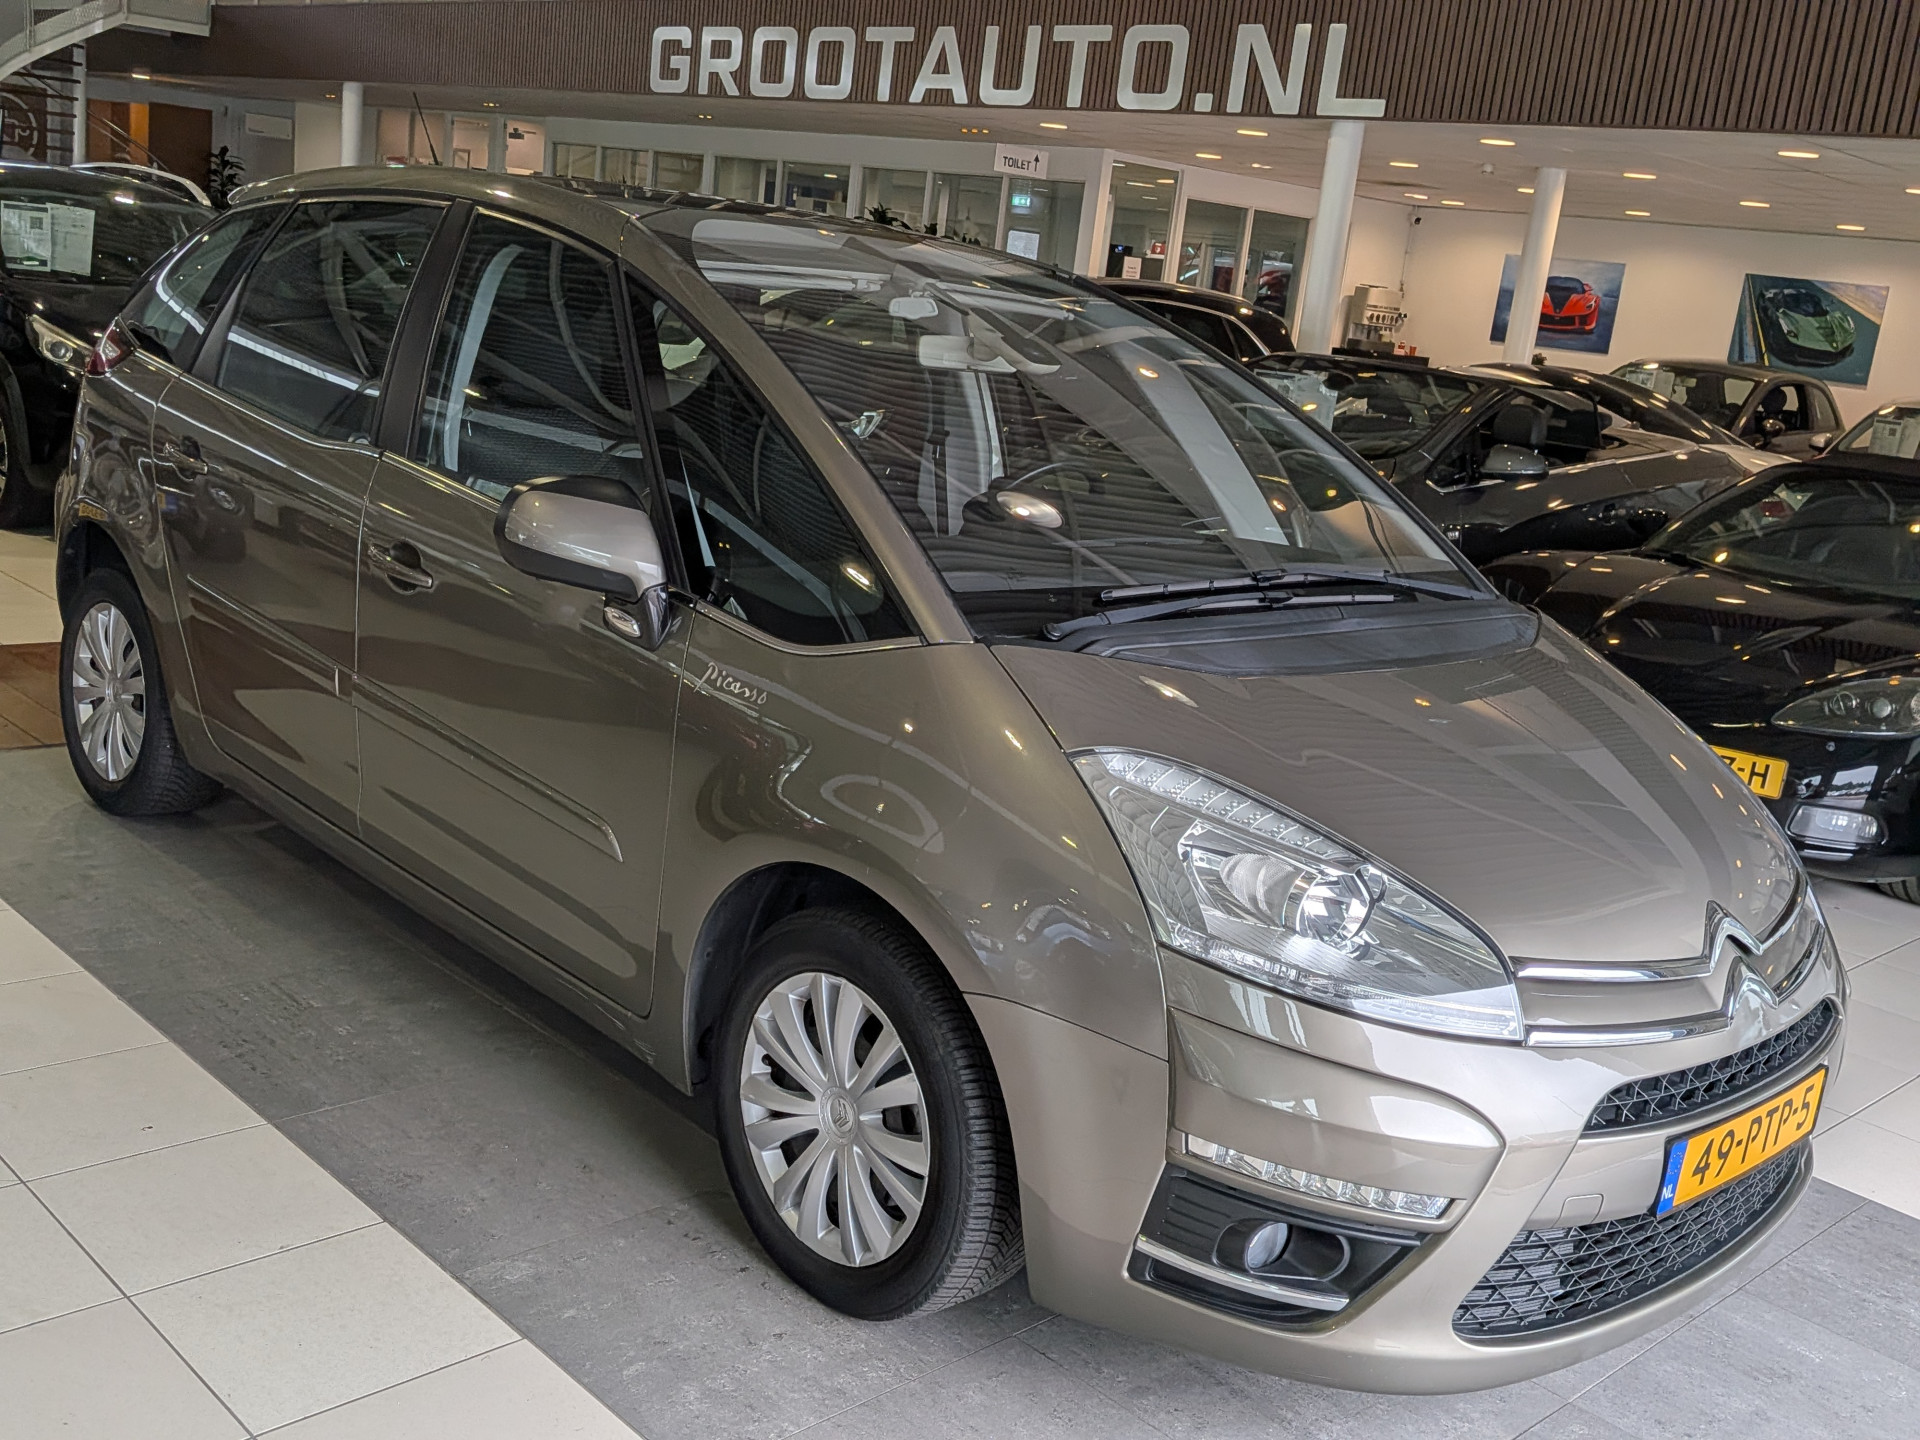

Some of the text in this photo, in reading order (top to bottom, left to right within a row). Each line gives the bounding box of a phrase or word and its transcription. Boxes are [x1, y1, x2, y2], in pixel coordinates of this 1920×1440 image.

[650, 23, 1386, 117] GROOTAUTO.NL
[1002, 155, 1031, 171] TOILET
[693, 661, 767, 705] Picasso
[1691, 1083, 1815, 1186] 49-PTP-5
[1660, 1183, 1674, 1202] NL
